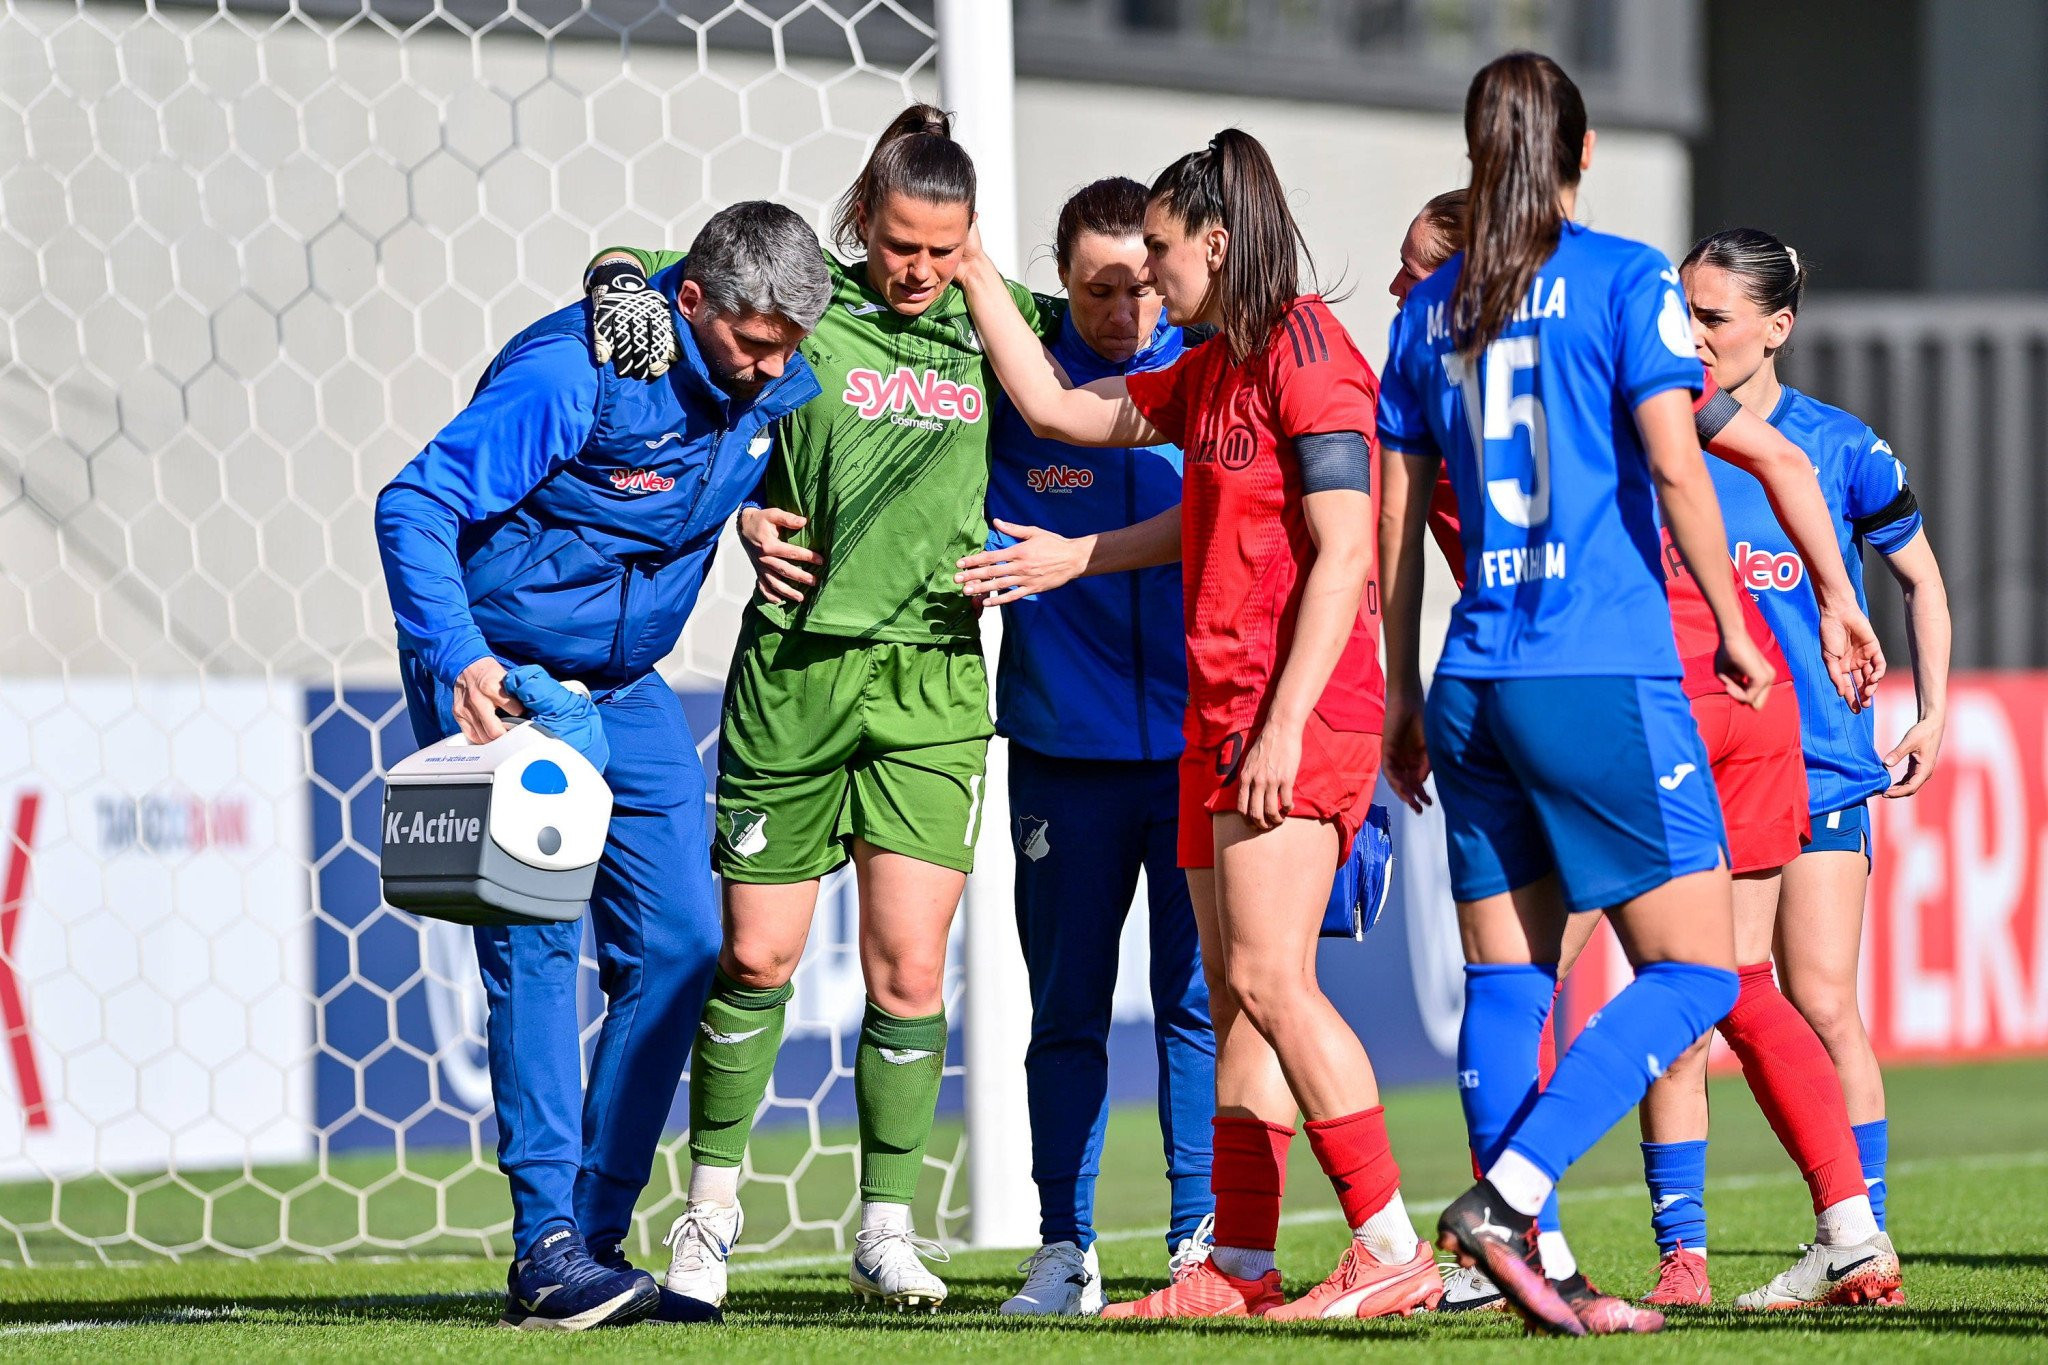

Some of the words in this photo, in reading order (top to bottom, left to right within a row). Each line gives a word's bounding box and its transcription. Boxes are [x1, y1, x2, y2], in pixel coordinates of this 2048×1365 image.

[842, 366, 984, 425] syNeo
[890, 413, 944, 432] Cosmetics
[1441, 333, 1550, 530] 15
[1026, 464, 1094, 493] syNeo
[384, 807, 481, 845] K-Active
[963, 773, 983, 848] 1
